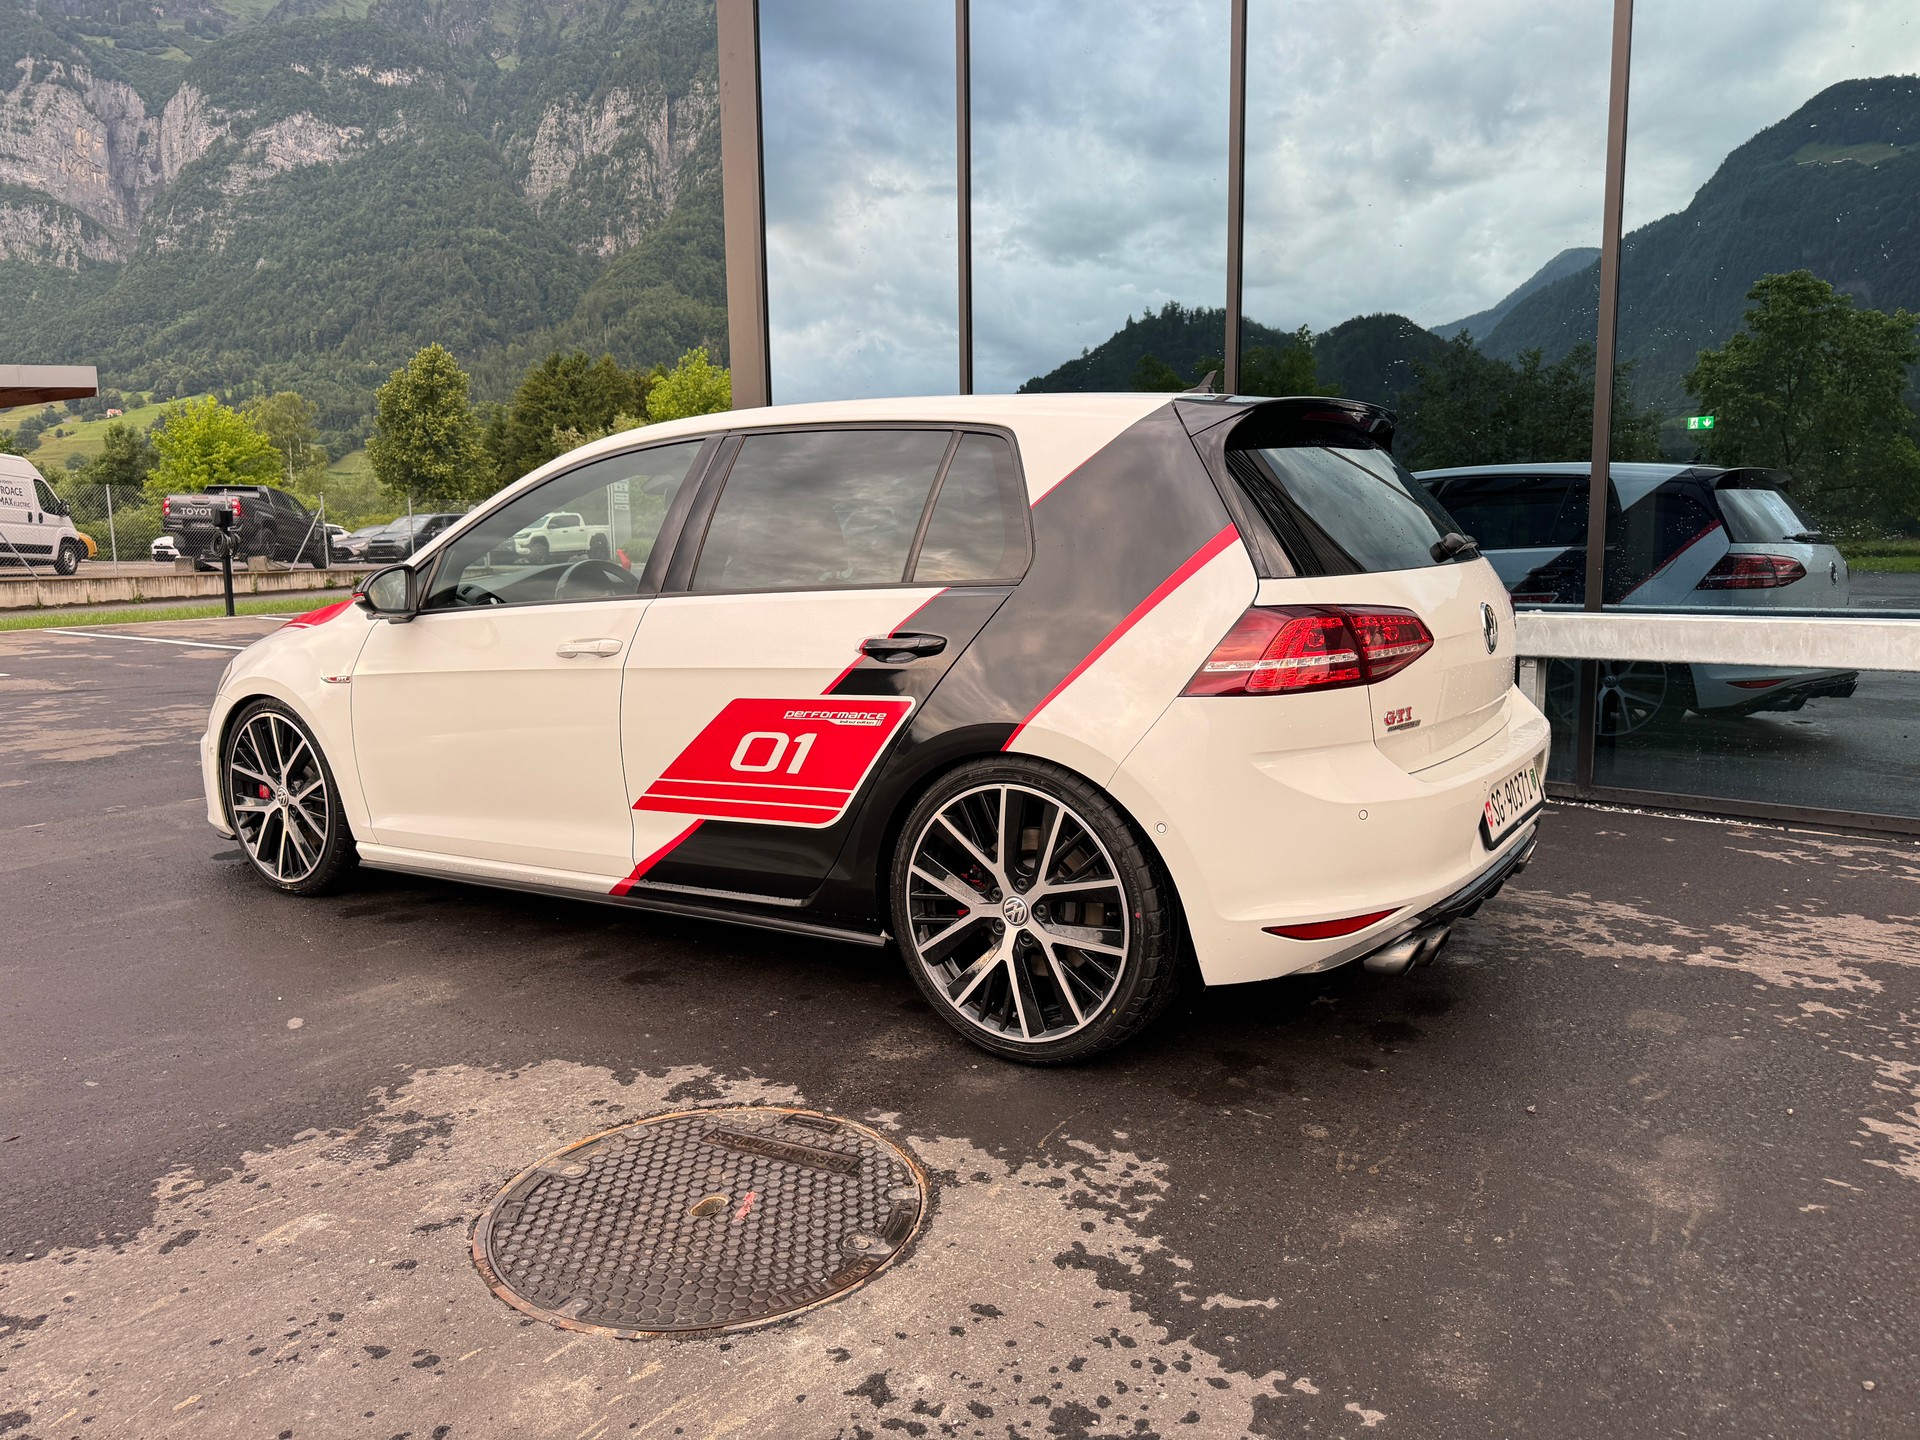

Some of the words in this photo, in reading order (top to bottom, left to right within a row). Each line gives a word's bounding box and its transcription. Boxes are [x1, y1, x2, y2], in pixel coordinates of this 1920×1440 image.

[0, 486, 23, 497] ROACE
[181, 508, 211, 516] TOYOT
[783, 710, 887, 720] performance
[1384, 706, 1412, 726] GTI
[730, 731, 818, 774] 01
